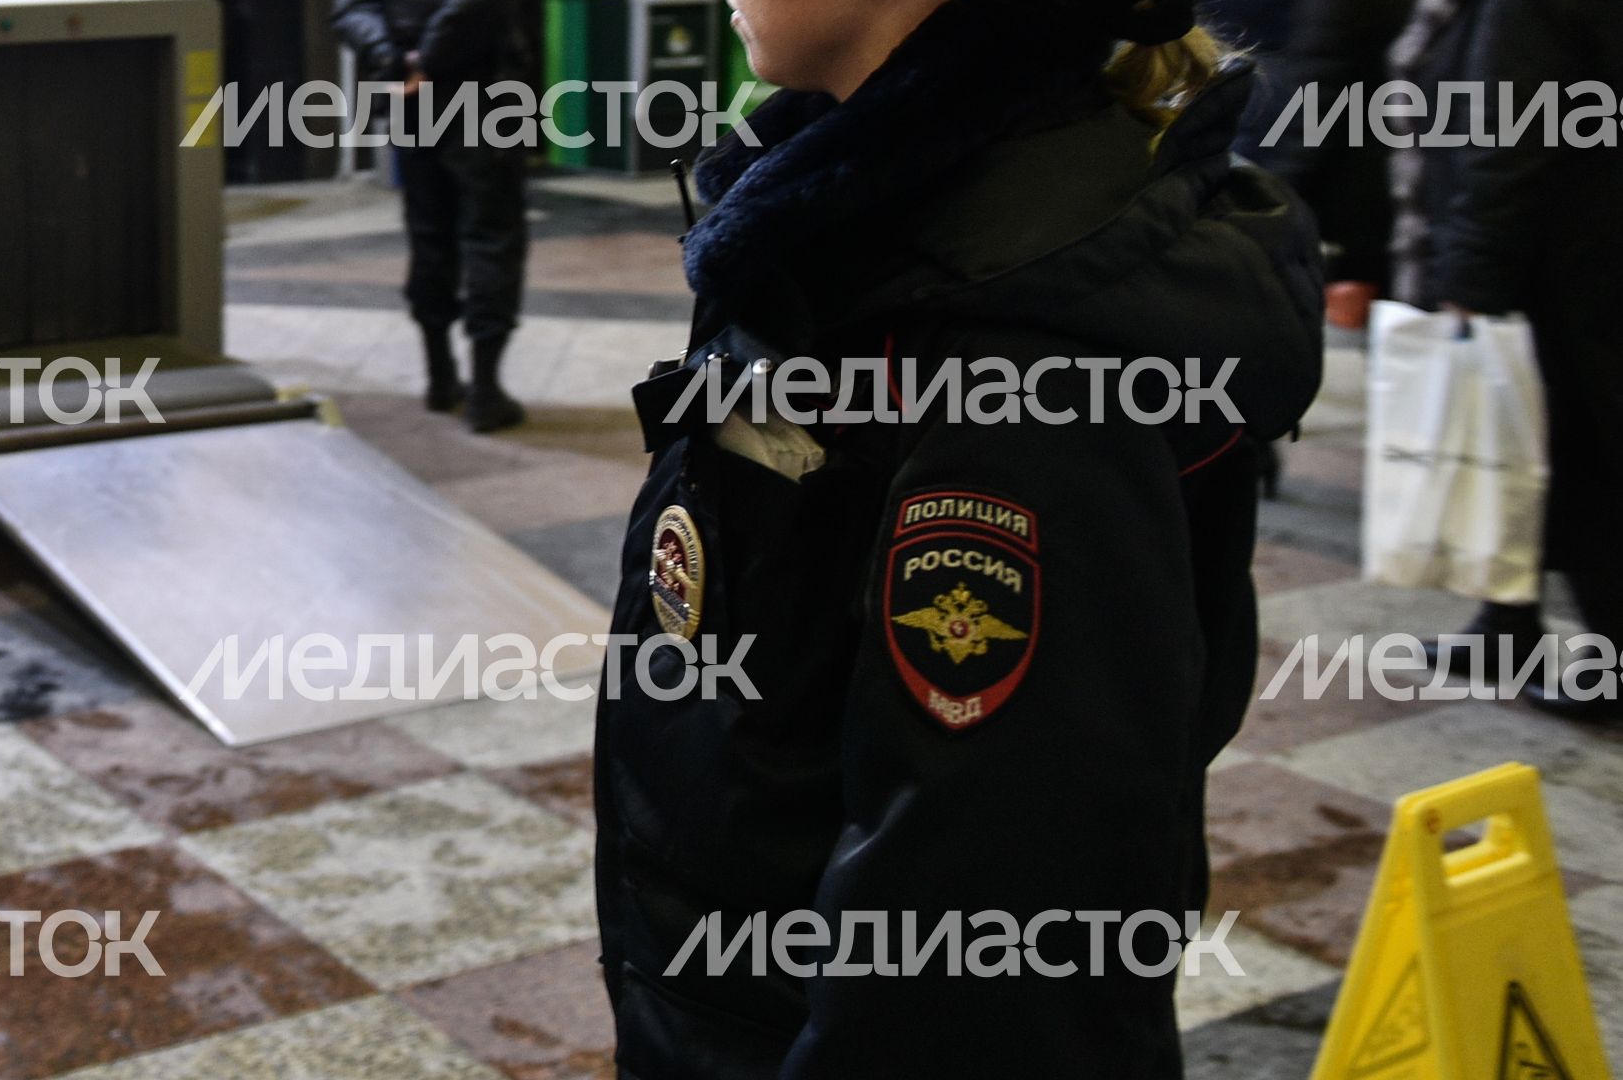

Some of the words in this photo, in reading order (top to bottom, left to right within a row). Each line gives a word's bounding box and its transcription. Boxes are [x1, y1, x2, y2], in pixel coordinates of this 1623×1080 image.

[904, 498, 1028, 537] ПОЛИЦИЯ
[904, 548, 1023, 594] РОССИЯ
[928, 689, 983, 724] МВД
